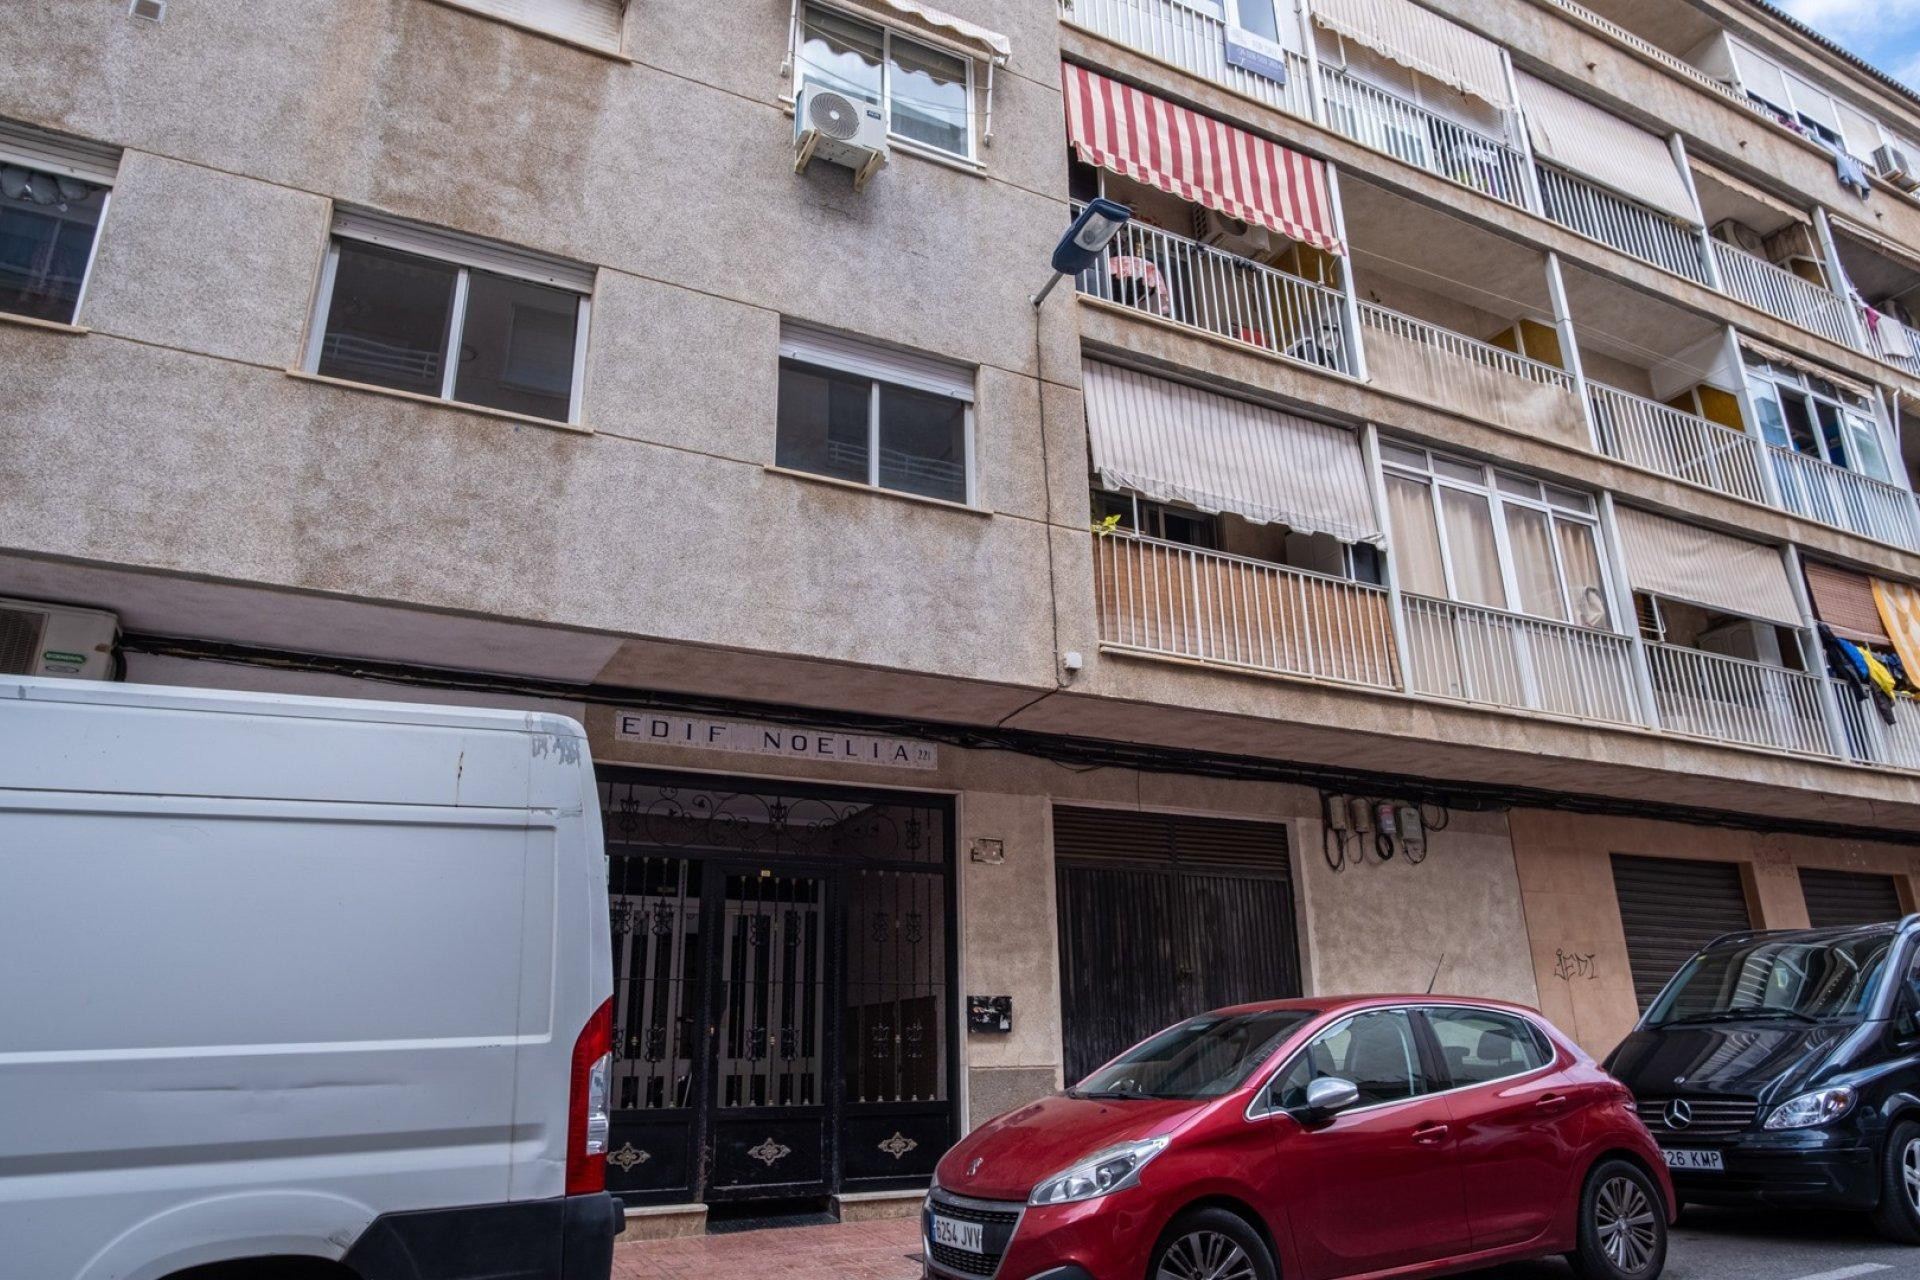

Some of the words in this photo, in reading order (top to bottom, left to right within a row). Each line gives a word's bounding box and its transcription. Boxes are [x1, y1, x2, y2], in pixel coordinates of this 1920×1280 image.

[622, 716, 726, 742] EDIF
[763, 731, 909, 761] NOELIA
[1690, 1151, 1719, 1167] KMP
